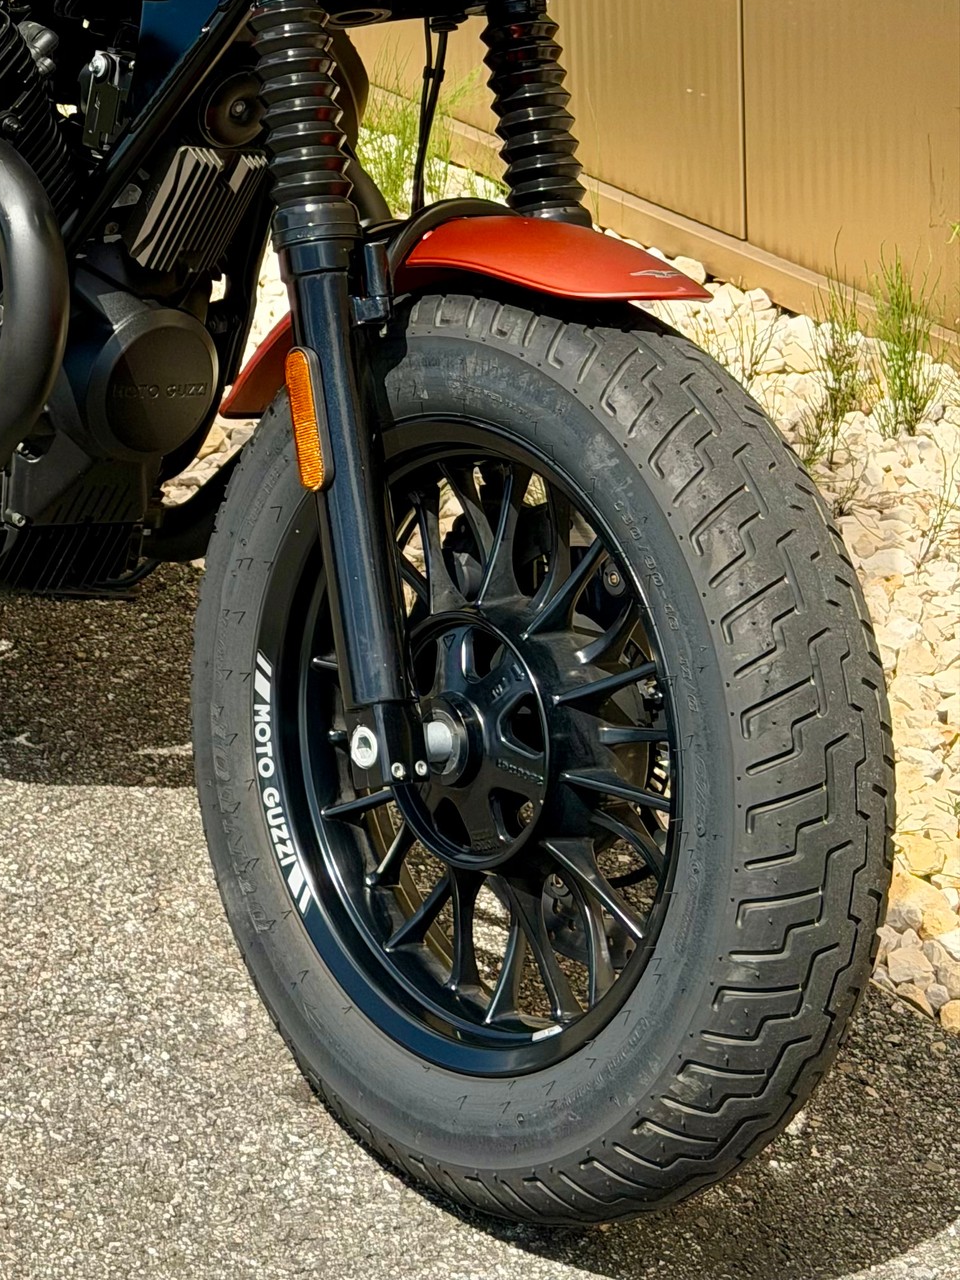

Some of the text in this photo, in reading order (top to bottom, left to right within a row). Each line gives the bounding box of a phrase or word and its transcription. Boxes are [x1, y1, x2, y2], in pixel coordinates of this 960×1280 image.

[112, 383, 208, 399] MOTO GUZZI
[253, 704, 296, 867] MOTO GUZZI
